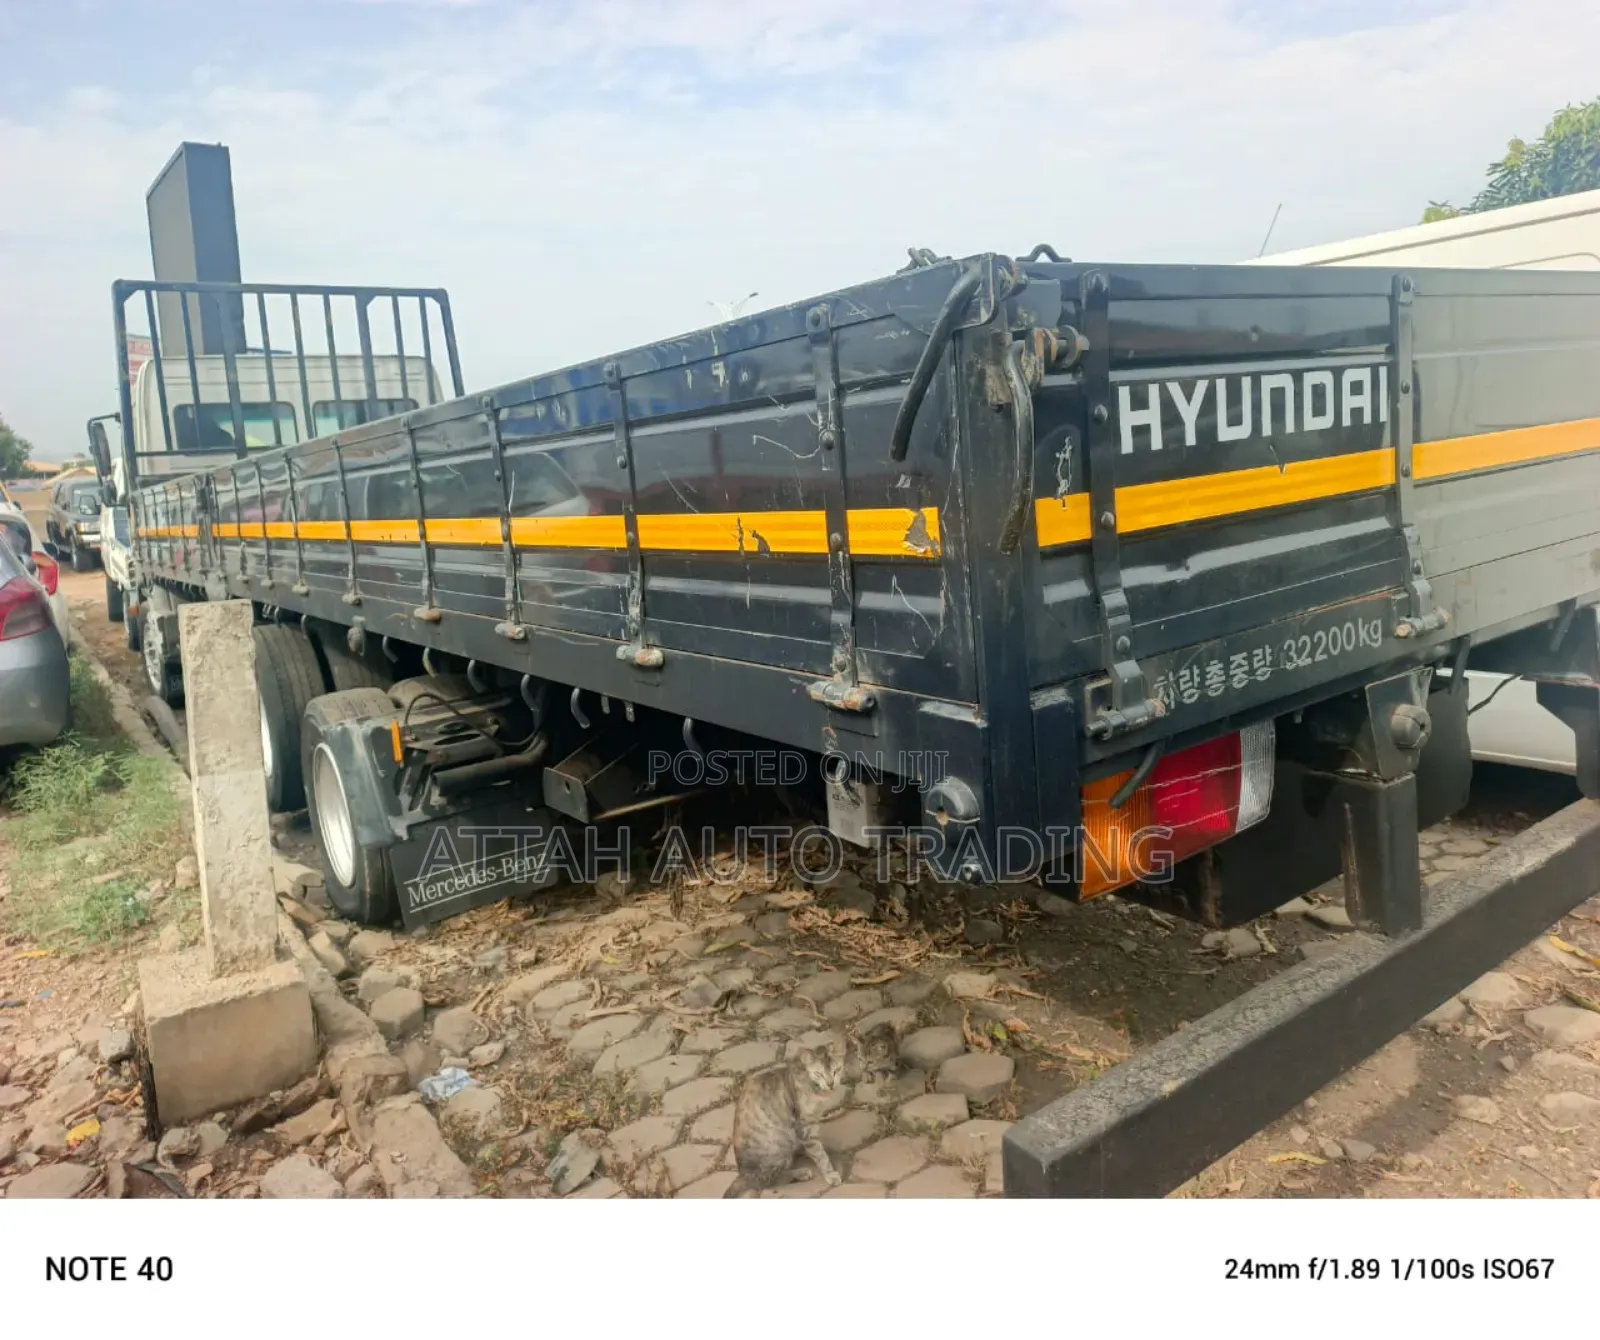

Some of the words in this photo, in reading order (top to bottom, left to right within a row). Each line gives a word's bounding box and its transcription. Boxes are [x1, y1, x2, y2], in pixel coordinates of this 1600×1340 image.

[1117, 366, 1389, 455] HYUNDAI
[1283, 617, 1383, 671] 32200kg
[407, 852, 547, 907] Mercedes-Benz
